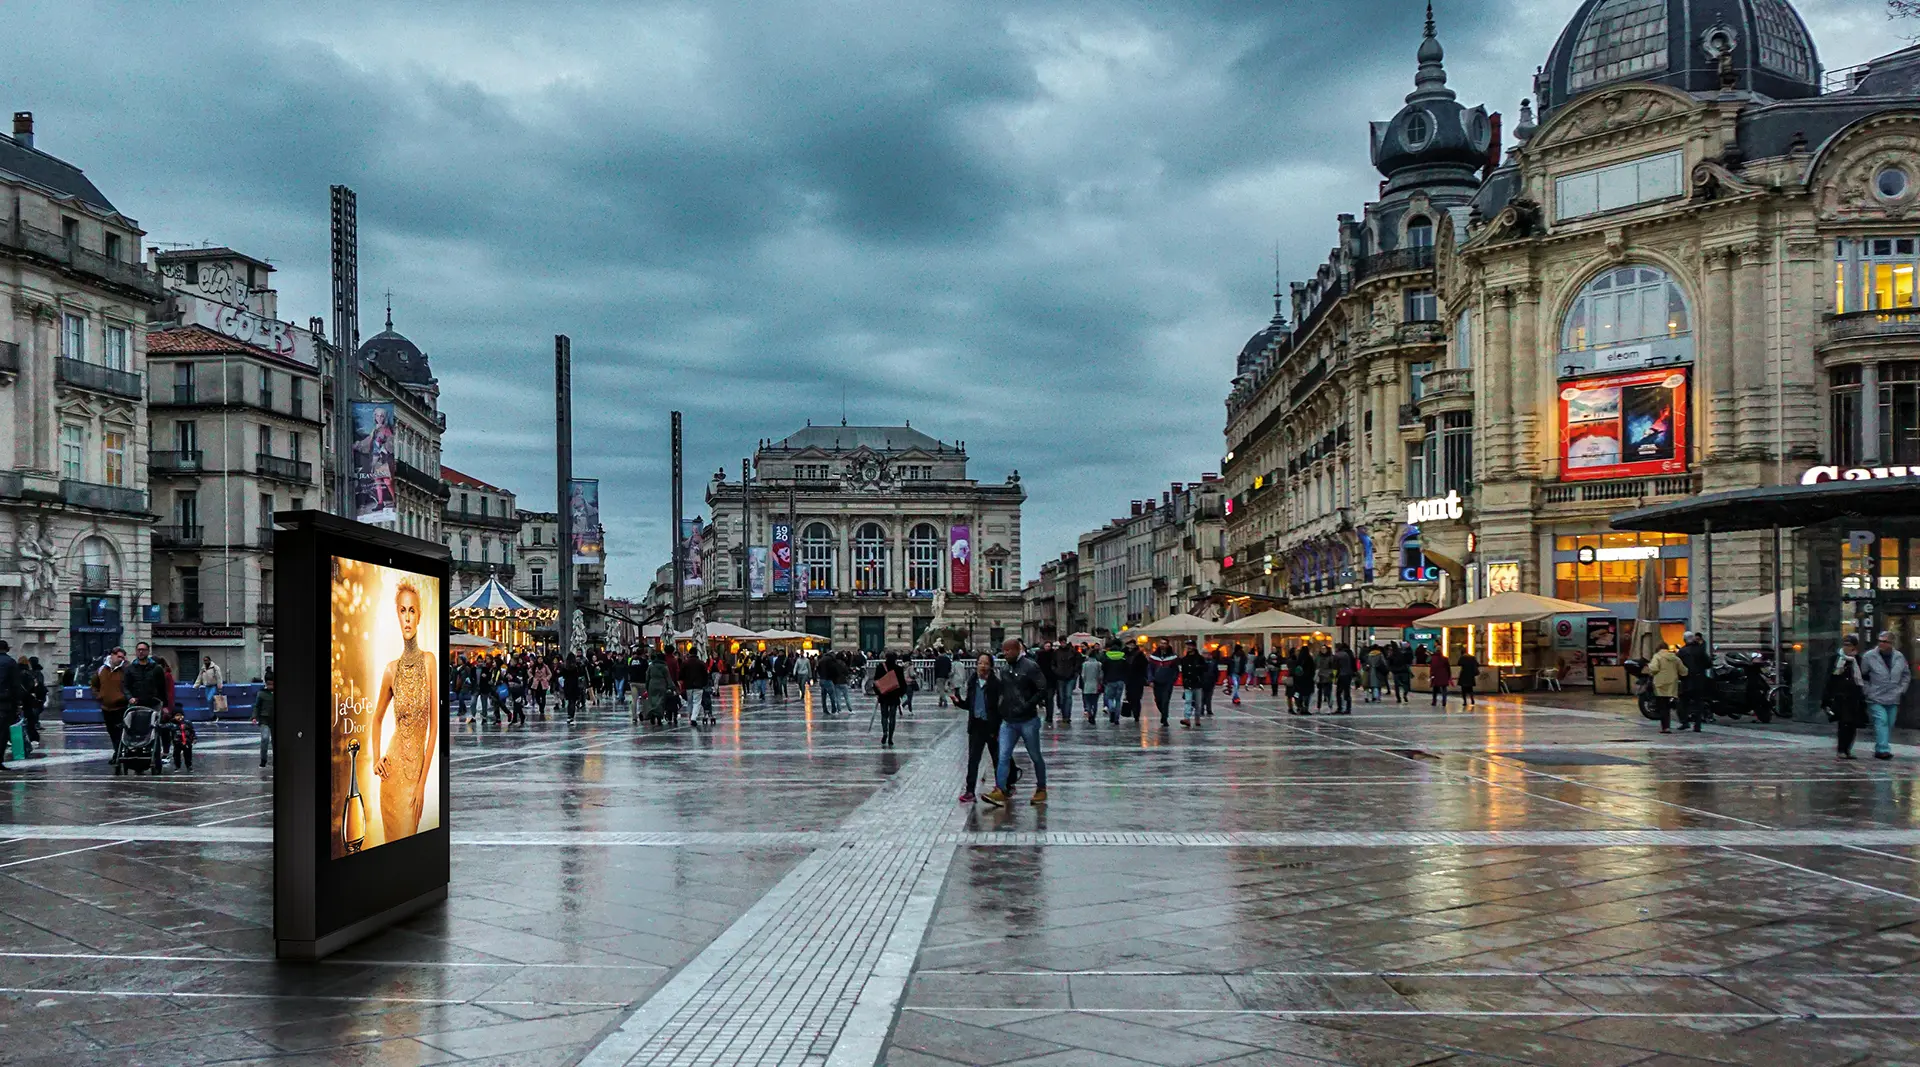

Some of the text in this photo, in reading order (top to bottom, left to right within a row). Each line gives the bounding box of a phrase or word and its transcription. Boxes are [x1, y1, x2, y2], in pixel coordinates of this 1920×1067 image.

[1402, 566, 1438, 581] CIC
[186, 628, 197, 636] de
[199, 627, 208, 636] la
[343, 717, 367, 735] Dior
